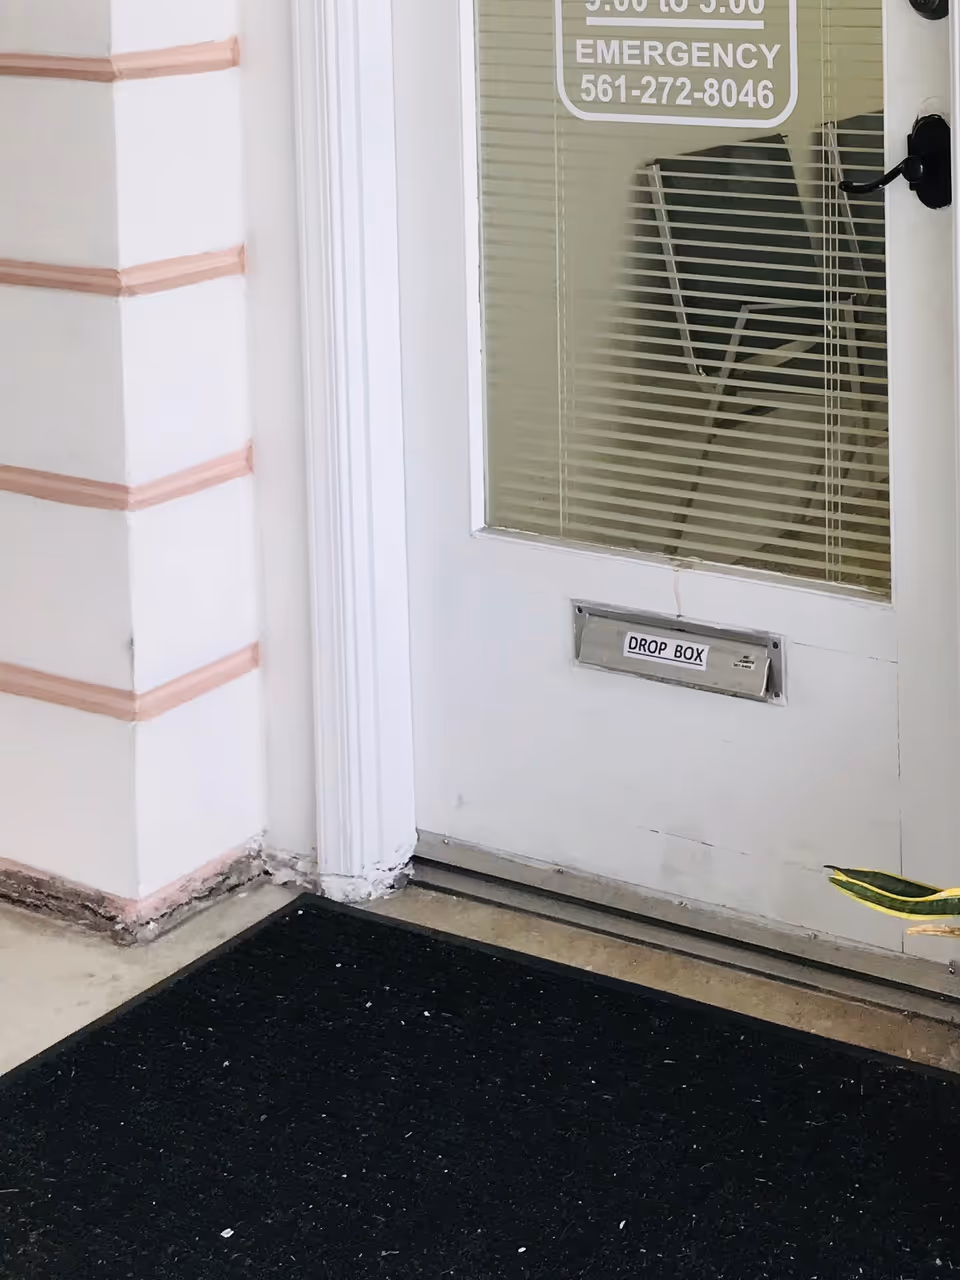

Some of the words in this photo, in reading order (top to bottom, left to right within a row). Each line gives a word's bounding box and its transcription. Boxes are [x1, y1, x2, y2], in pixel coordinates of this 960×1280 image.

[575, 38, 782, 69] EMERGENCY
[580, 74, 775, 109] 561-272-8046
[627, 635, 668, 656] DROP
[674, 644, 705, 663] BOX
